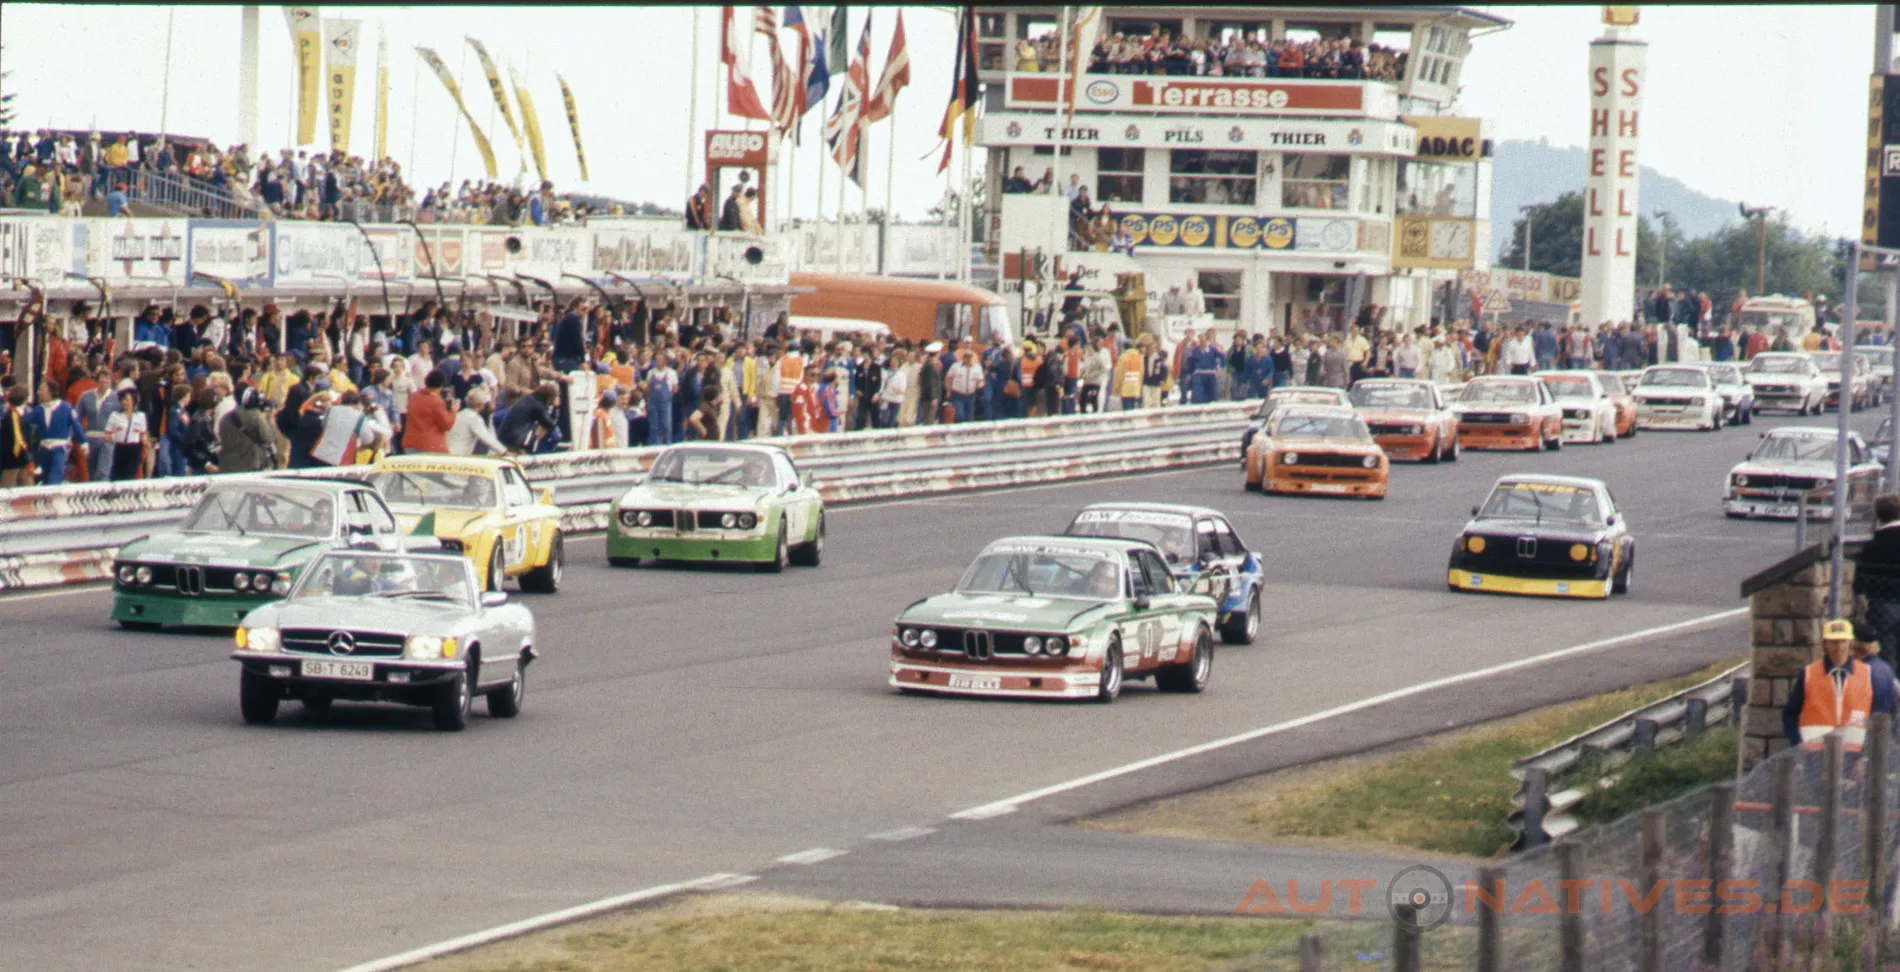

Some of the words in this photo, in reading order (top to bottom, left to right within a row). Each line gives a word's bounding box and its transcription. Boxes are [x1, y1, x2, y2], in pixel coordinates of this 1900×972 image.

[1147, 80, 1288, 109] Terrasse
[1164, 130, 1204, 143] PILS
[1270, 132, 1326, 145] THIER
[1419, 136, 1475, 157] ADAC
[1588, 66, 1609, 257] SHELL
[1616, 68, 1639, 257] SHELL
[1153, 219, 1174, 233] PS
[1183, 220, 1205, 234] PS
[1234, 222, 1257, 235] PS
[1266, 223, 1290, 236] PS
[1077, 265, 1100, 280] Der
[340, 663, 369, 677] 6249
